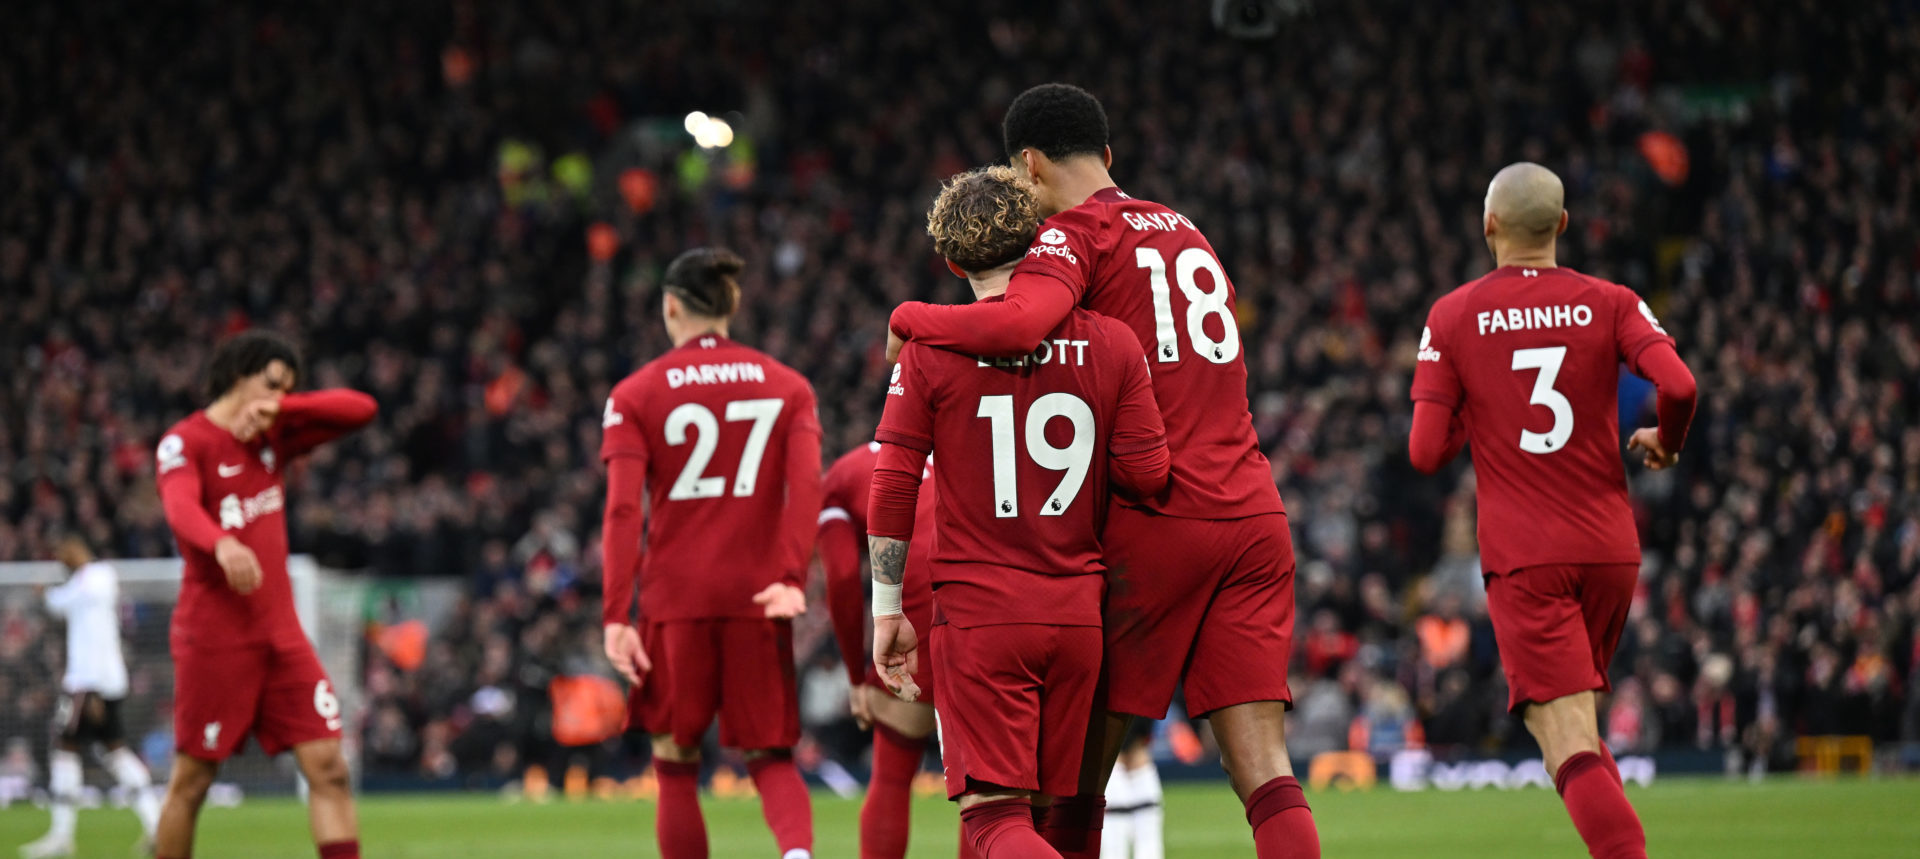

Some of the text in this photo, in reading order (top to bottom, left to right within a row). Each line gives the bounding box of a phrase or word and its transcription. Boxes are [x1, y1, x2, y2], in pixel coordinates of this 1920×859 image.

[1122, 211, 1196, 231] GAKPO
[1135, 247, 1240, 364] 18
[1477, 305, 1593, 335] FABINHO
[666, 362, 765, 389] DARWIN
[1511, 346, 1574, 454] 3
[664, 398, 784, 500] 27
[976, 392, 1096, 518] 19
